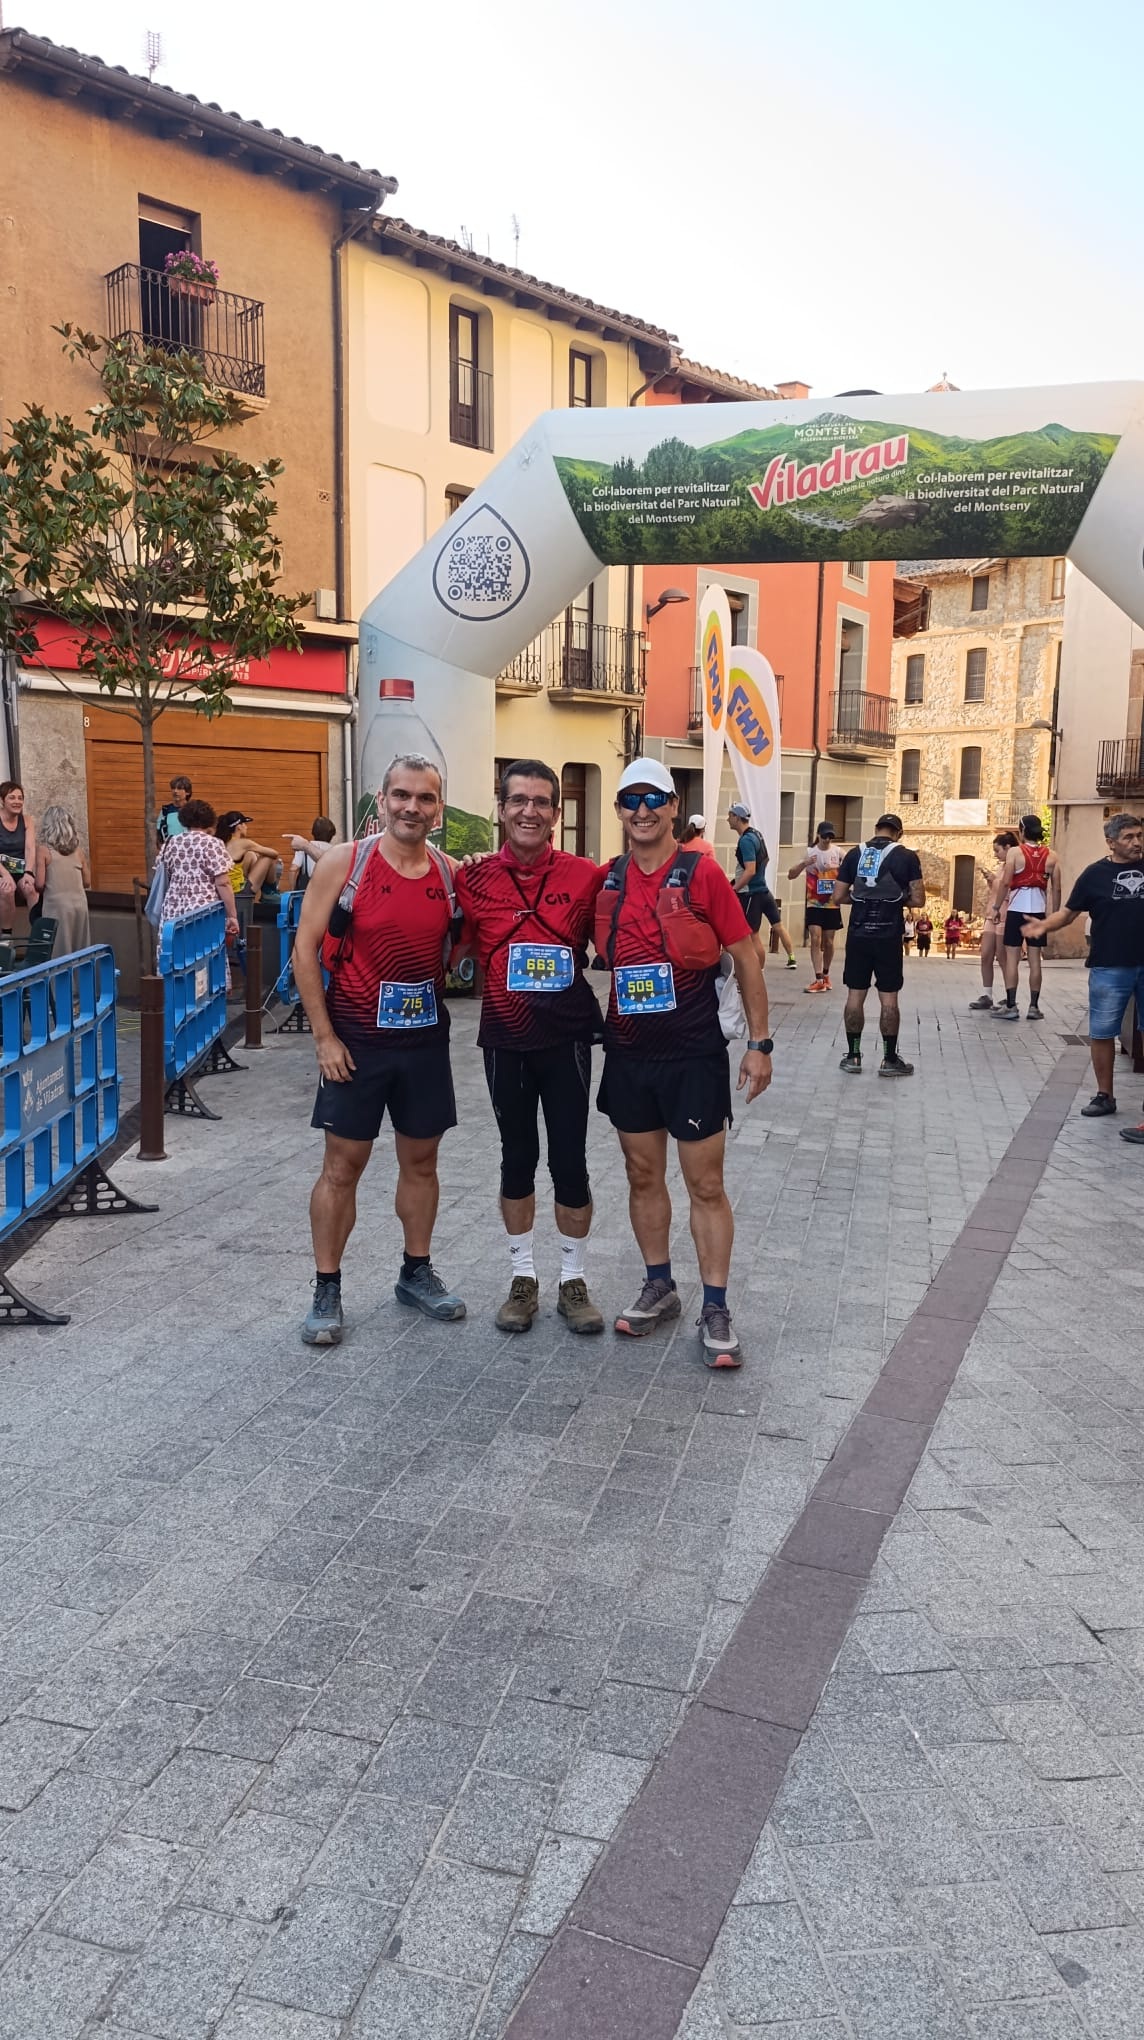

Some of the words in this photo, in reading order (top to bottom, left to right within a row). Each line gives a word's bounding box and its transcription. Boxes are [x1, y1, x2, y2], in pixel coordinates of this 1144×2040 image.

[794, 425, 866, 438] MONTSENY
[749, 434, 908, 510] Viladrau
[987, 471, 1008, 483] per
[1009, 467, 1074, 480] revitalitzar
[654, 485, 672, 497] per
[673, 482, 730, 494] revitalitzar
[905, 489, 915, 500] la
[917, 486, 990, 500] biodiversitat
[991, 485, 1010, 497] del
[1012, 485, 1038, 496] Parc
[1040, 481, 1084, 495] Natural
[583, 501, 593, 512] la
[594, 500, 658, 512] biodiversitat
[659, 498, 676, 509] del
[677, 498, 700, 508] Parc
[701, 496, 740, 508] Natural
[953, 502, 972, 513] del
[974, 501, 1031, 513] Montseny
[628, 514, 644, 524] del
[646, 514, 695, 524] Montseny
[84, 716, 90, 728] 8
[526, 958, 555, 971] 663
[627, 979, 654, 993] 509
[402, 997, 423, 1009] 715
